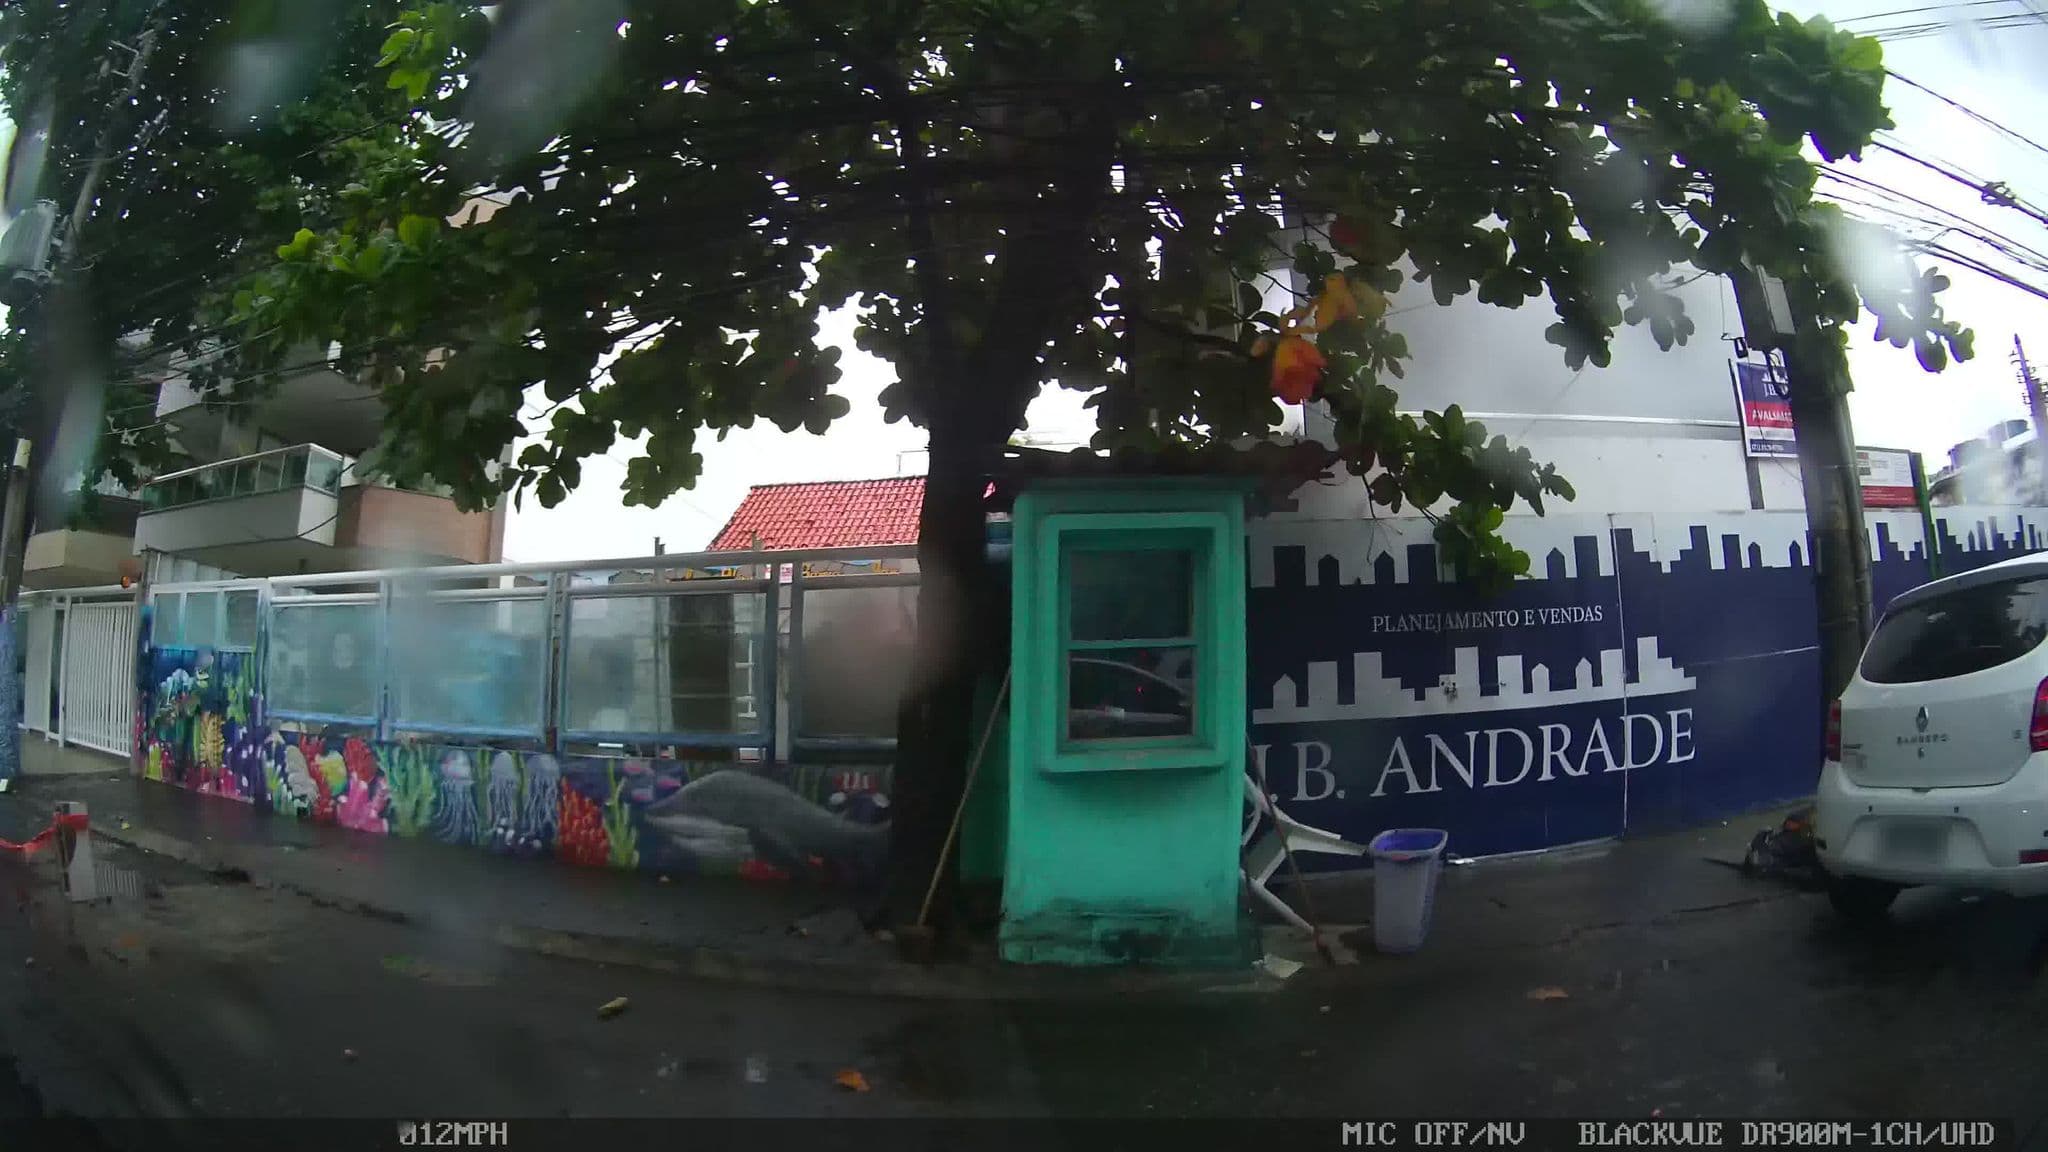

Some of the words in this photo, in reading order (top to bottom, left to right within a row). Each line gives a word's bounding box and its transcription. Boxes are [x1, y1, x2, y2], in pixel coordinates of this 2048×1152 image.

[1372, 609, 1520, 634] PLANEJAMENTO
[1524, 609, 1536, 627] E
[1538, 604, 1604, 626] VENDAS
[1369, 708, 1697, 798] ANDRADE
